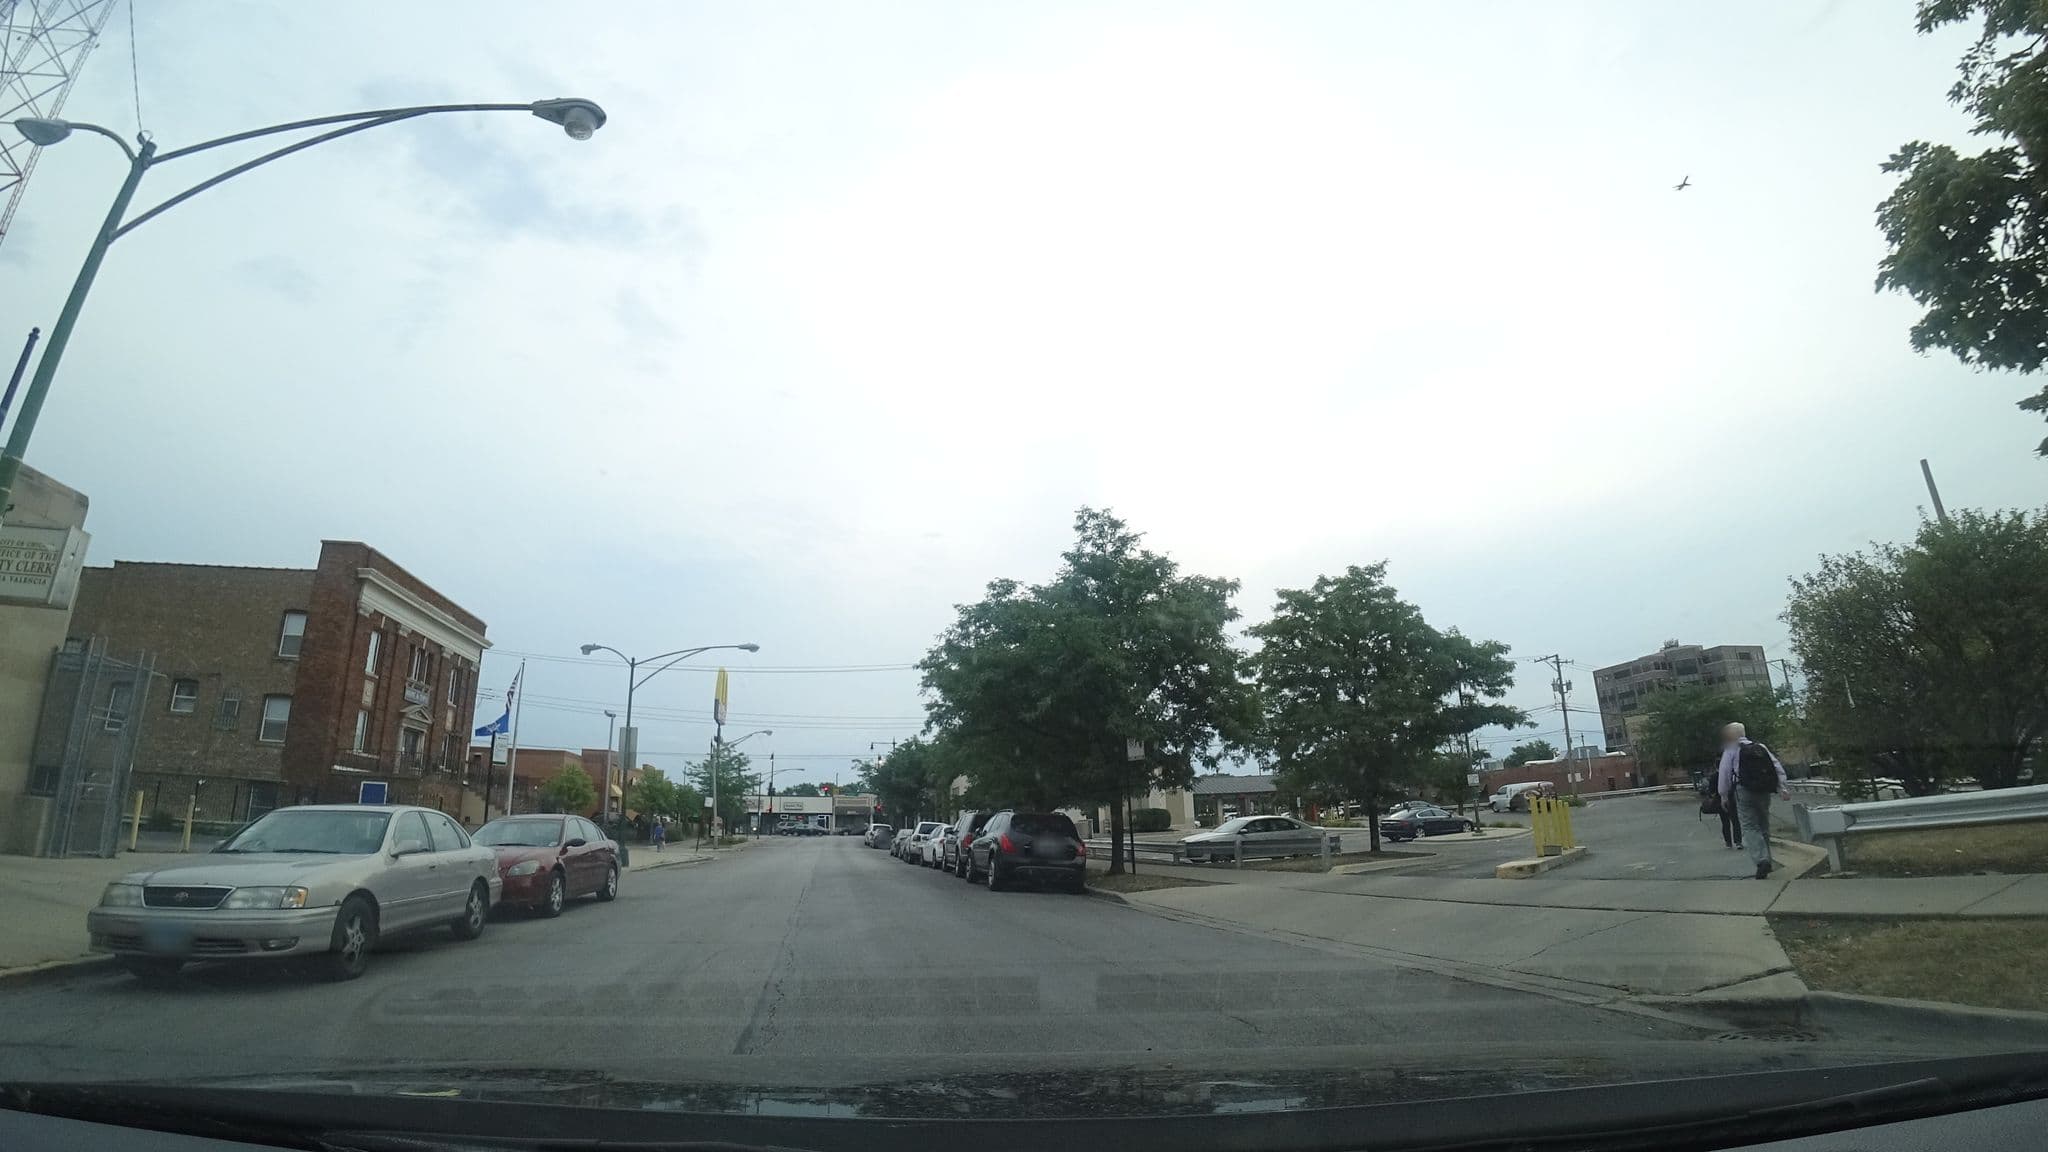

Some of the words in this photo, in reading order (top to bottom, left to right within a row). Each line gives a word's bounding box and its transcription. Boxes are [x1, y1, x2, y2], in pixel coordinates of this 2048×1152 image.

[24, 550, 36, 559] OF
[40, 551, 57, 561] THE
[16, 560, 54, 574] CLERK
[10, 576, 47, 585] VALENCIA
